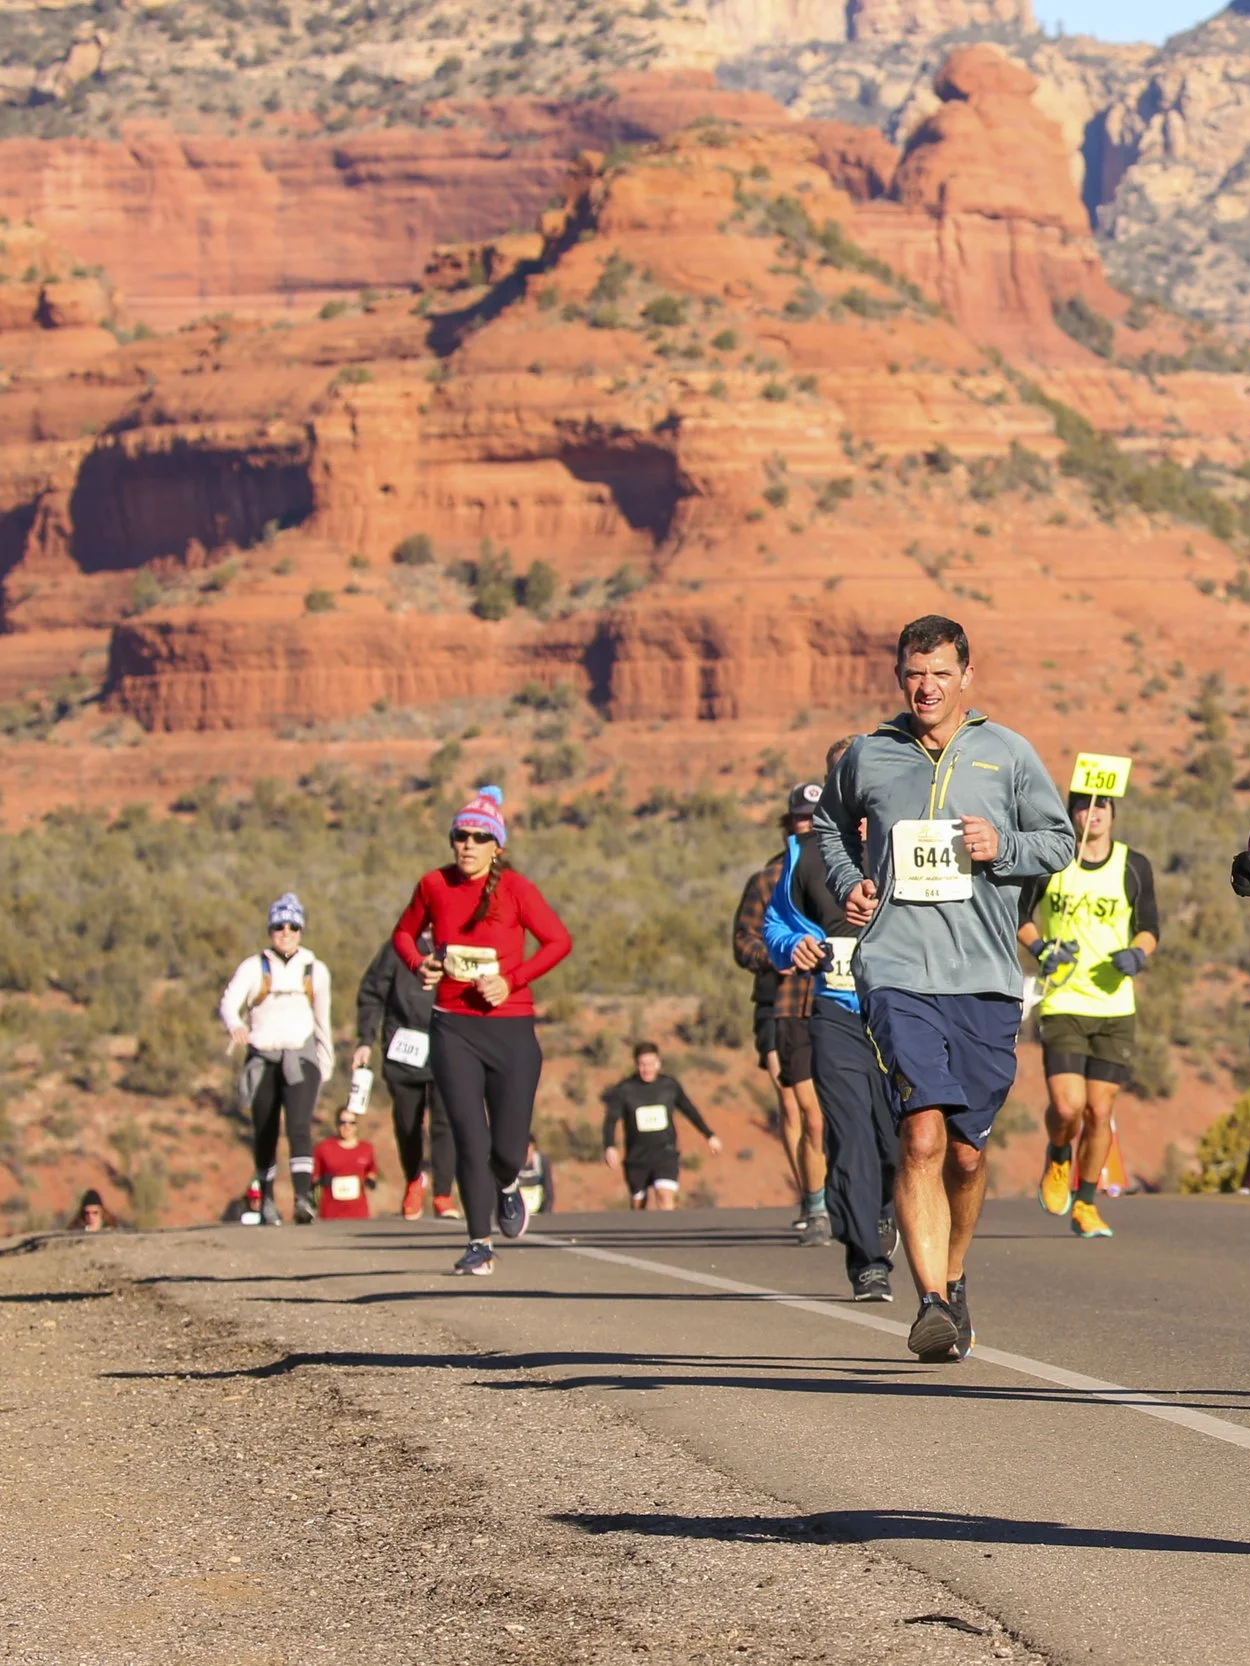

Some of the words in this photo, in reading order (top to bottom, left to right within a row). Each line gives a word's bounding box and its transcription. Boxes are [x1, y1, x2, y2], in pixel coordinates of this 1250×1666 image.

[1084, 770, 1116, 790] 1:50
[914, 846, 951, 868] 644
[1049, 892, 1118, 917] BEAST
